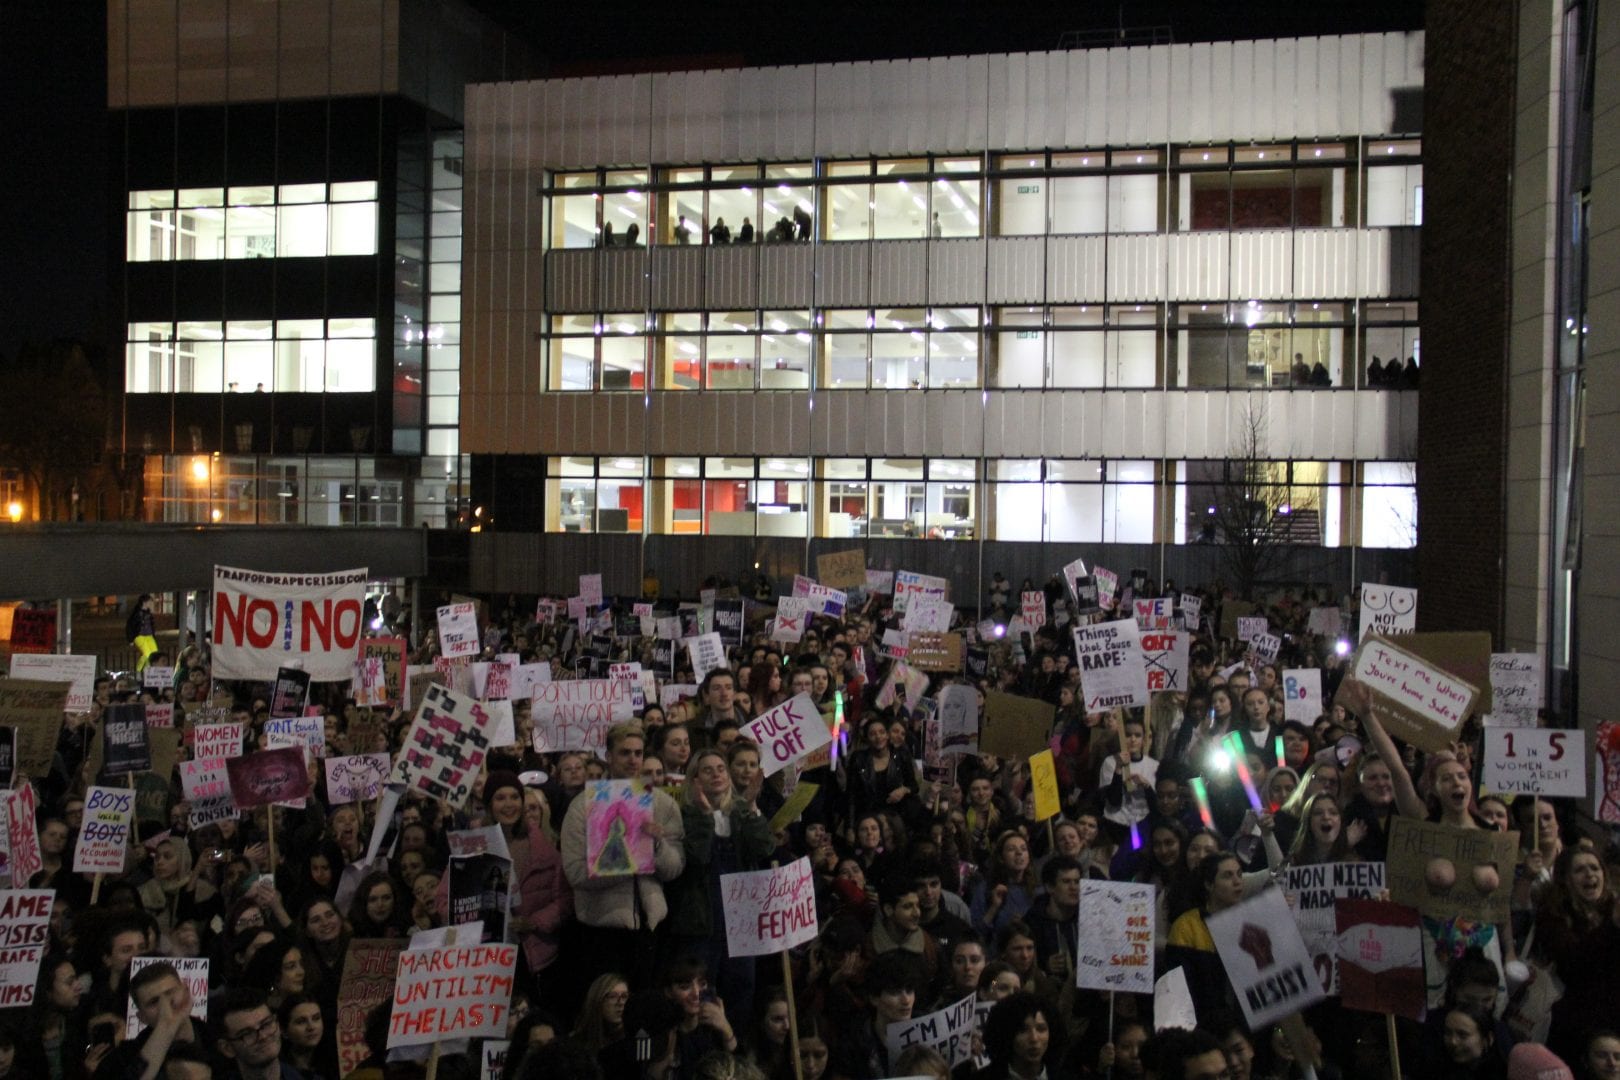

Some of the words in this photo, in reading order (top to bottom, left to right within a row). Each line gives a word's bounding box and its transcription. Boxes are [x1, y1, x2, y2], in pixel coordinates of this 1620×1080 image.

[1135, 600, 1165, 616] WE
[1374, 614, 1398, 624] NOT
[214, 592, 279, 649] NO
[284, 600, 294, 651] MEANS
[301, 599, 361, 652] NO
[1076, 626, 1118, 643] Things
[1252, 633, 1279, 649] CATS
[1079, 643, 1101, 654] that
[1105, 640, 1132, 651] cause
[1082, 651, 1127, 672] RAPE:
[588, 678, 633, 702] TOUCH
[1100, 694, 1134, 708] RAPISTS
[552, 702, 620, 726] ANYONE
[750, 700, 804, 744] FUCK
[196, 726, 240, 743] WOMEN
[534, 723, 573, 750] BUT
[772, 727, 805, 762] OFF
[1503, 731, 1517, 758] 1
[1526, 747, 1538, 757] IN
[1548, 732, 1567, 761] 5
[196, 742, 240, 758] UNITE
[1495, 761, 1543, 771] WOMEN
[87, 789, 132, 813] BOYS
[84, 821, 126, 845] BOYS
[1288, 865, 1326, 890] NON
[1333, 863, 1382, 887] NIEN
[0, 895, 52, 920] AME
[757, 896, 815, 941] FEMALE
[1126, 916, 1148, 927] OUR
[1125, 930, 1151, 941] TIME
[183, 960, 198, 970] NOT
[200, 961, 208, 970] A
[400, 946, 514, 977] MARCHING
[1109, 953, 1149, 966] SHINE
[395, 975, 470, 1004] UNTIL
[472, 974, 513, 998] I'M
[392, 1006, 438, 1034] THE
[438, 1003, 506, 1032] LAST
[899, 1017, 938, 1050] I'M
[944, 994, 976, 1033] WITH
